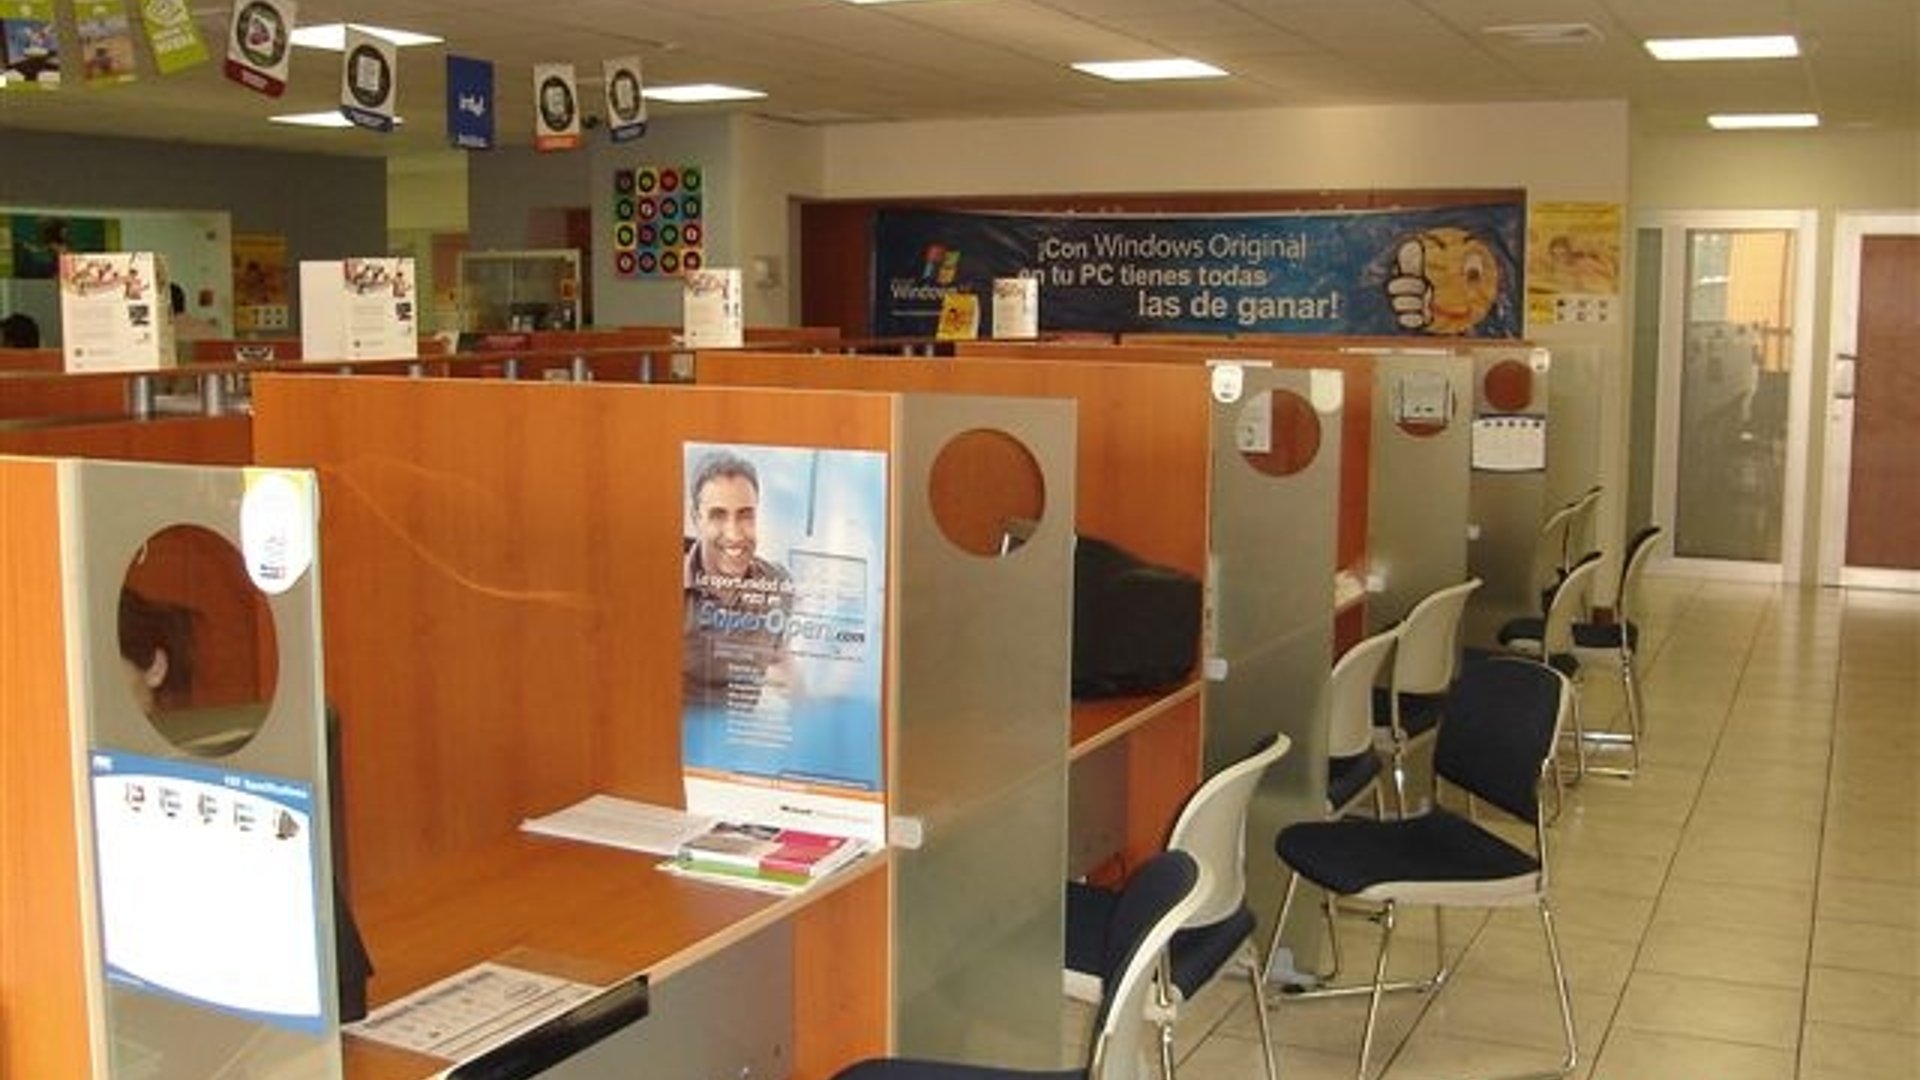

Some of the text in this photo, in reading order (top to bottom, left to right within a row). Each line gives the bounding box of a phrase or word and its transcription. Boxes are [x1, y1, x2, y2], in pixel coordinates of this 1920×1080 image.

[1038, 233, 1307, 264] ¡Con Windows Original
[1052, 264, 1074, 285] tu
[1080, 264, 1114, 286] PC
[1120, 264, 1191, 287] tienes
[1199, 265, 1269, 287] todas
[1139, 291, 1341, 326] las de ganar!
